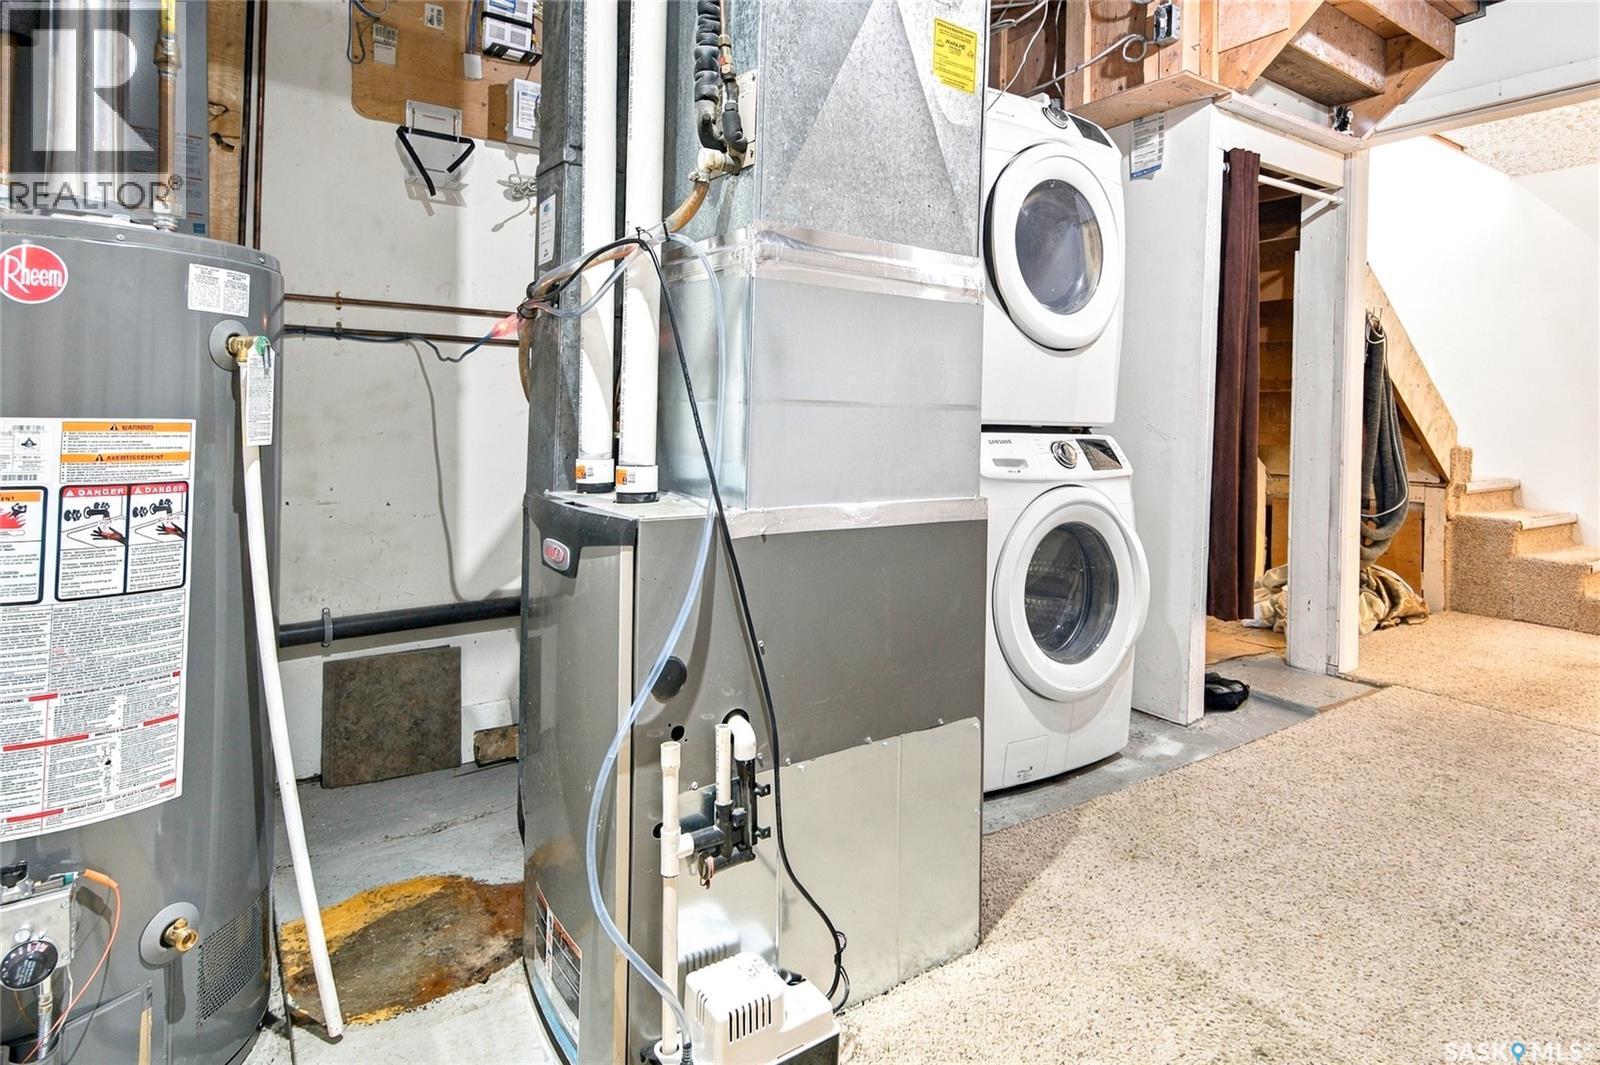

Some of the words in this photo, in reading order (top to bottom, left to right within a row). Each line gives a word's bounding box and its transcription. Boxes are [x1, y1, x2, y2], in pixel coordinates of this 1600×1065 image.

[3, 241, 63, 294] Rheem
[78, 487, 125, 496] DANGER
[144, 485, 186, 494] DANGER
